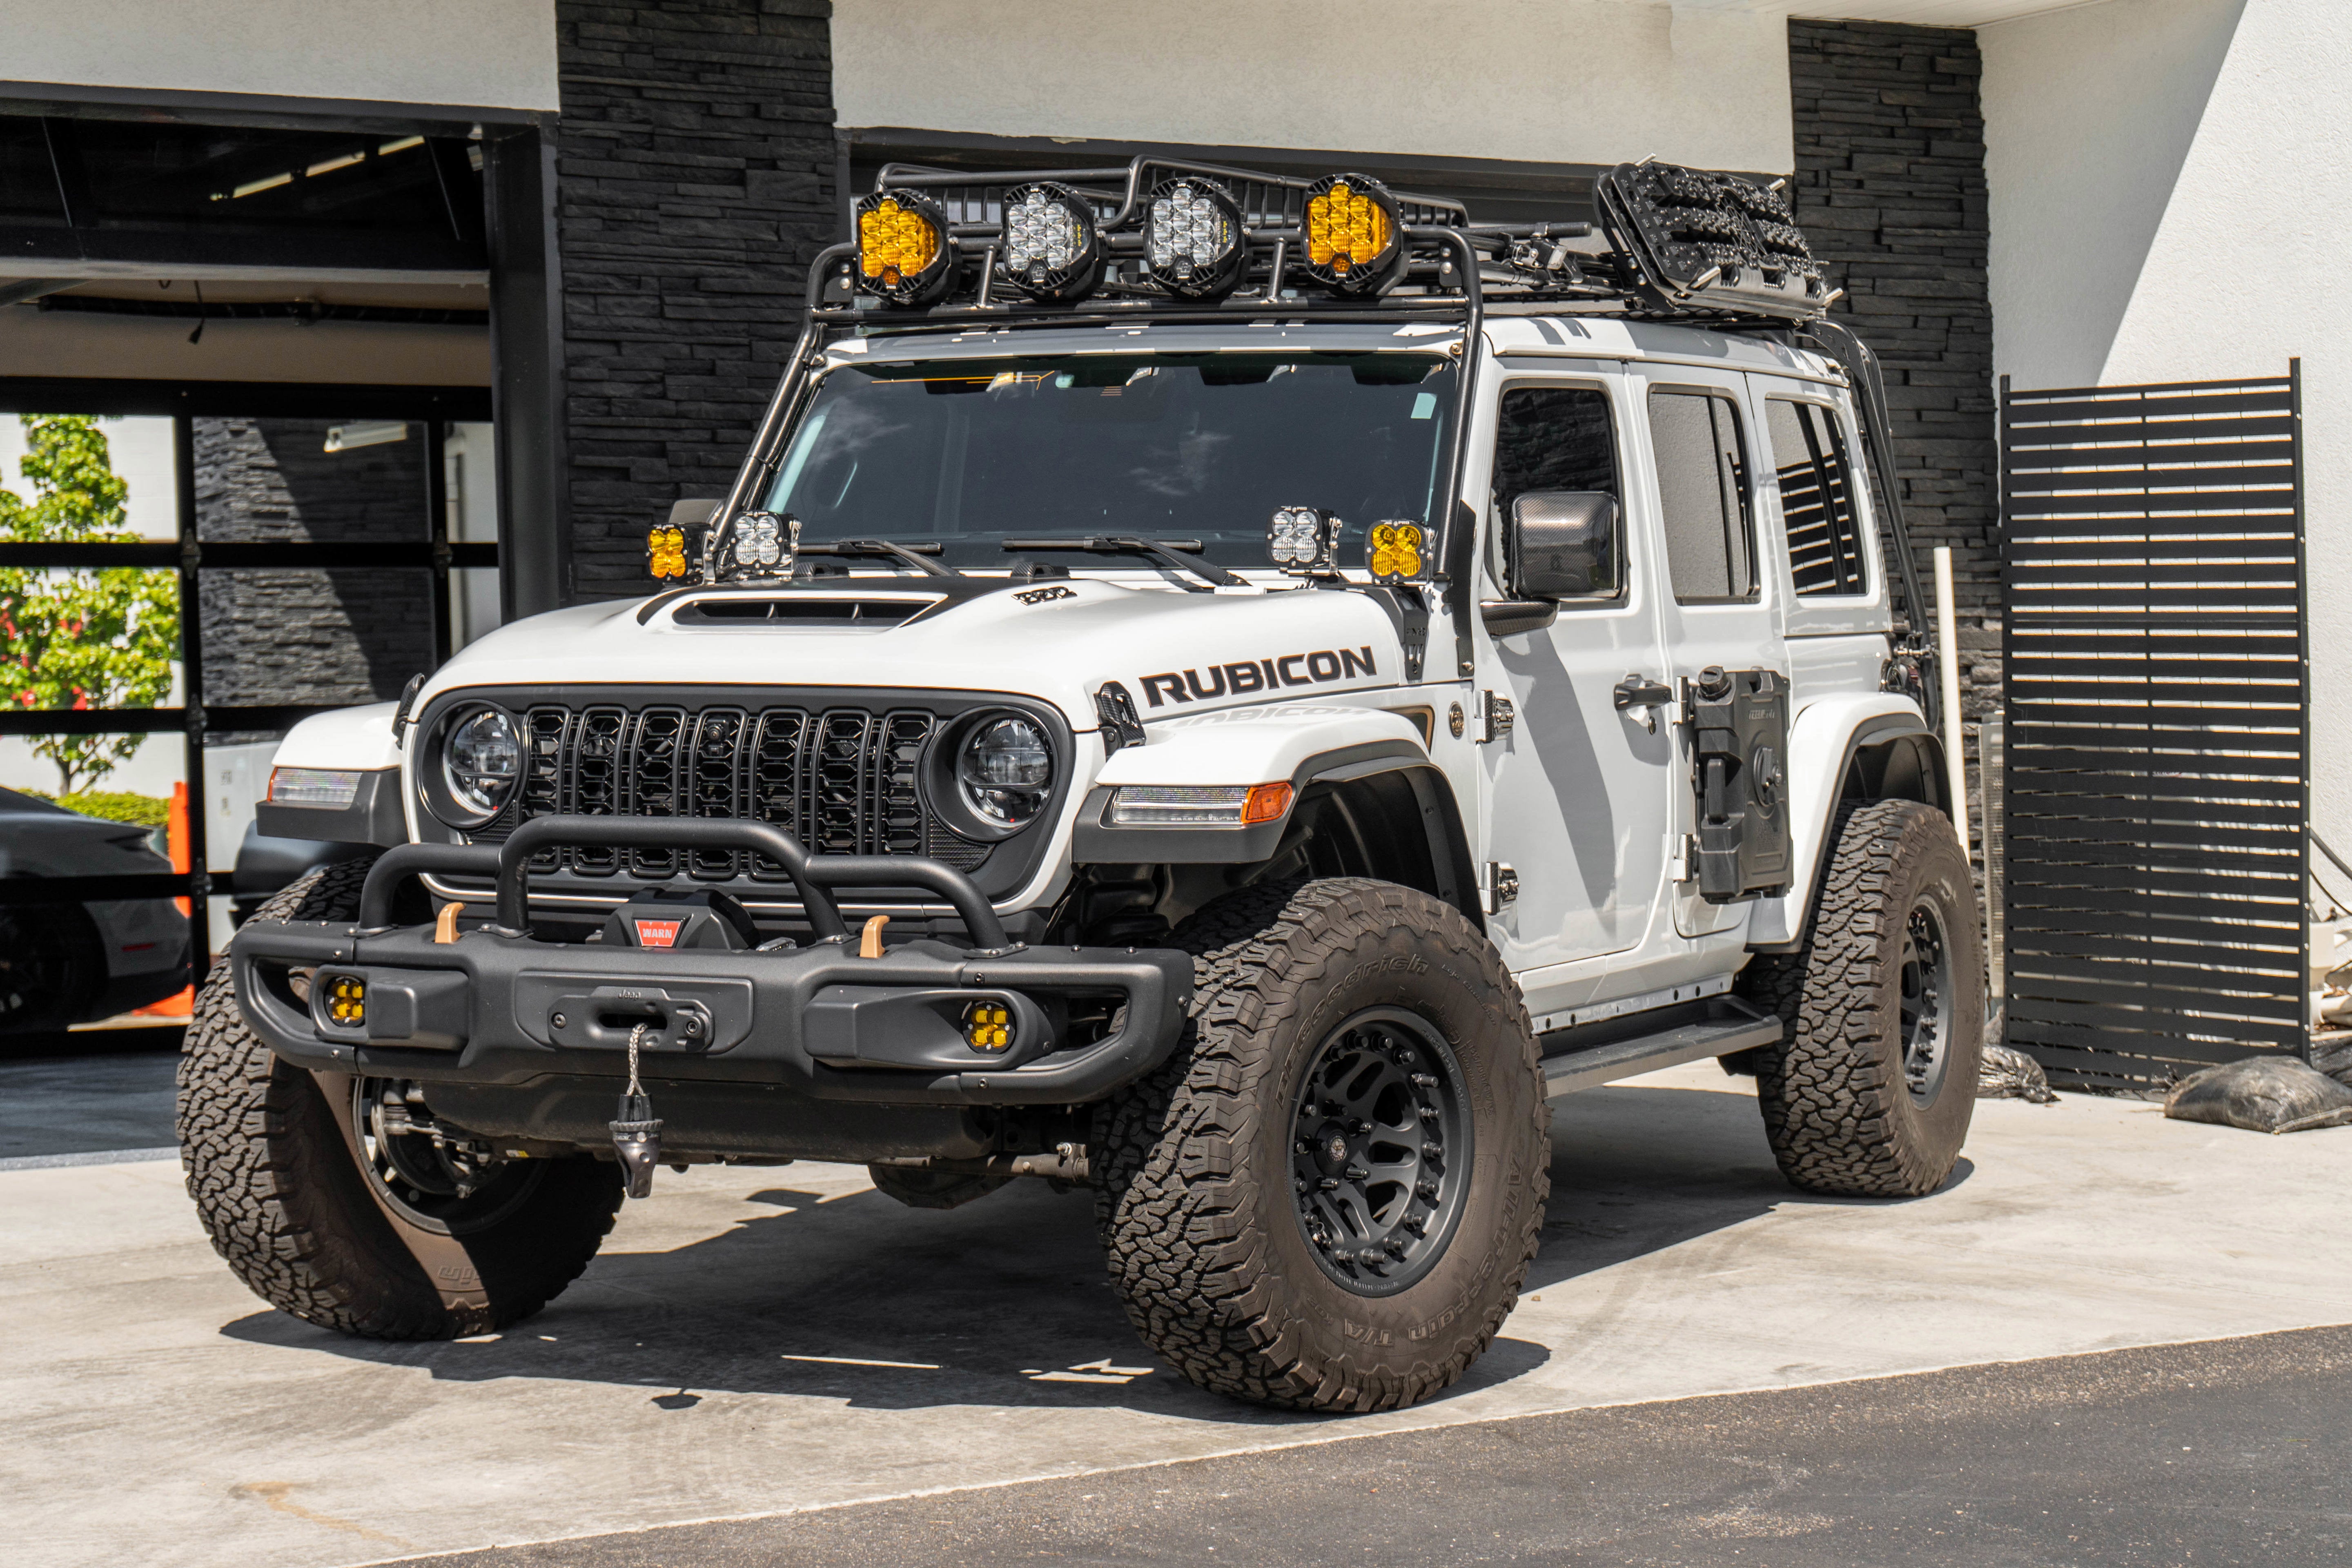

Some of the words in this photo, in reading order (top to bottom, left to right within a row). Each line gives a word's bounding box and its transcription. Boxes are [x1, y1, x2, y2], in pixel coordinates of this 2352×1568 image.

[1138, 645, 1377, 708] RUBICON
[642, 928, 672, 938] WARN
[618, 989, 641, 1000] Jeep
[1275, 953, 1429, 1110] BFGoodrich
[1408, 1152, 1522, 1342] All-Terrain
[1345, 1318, 1393, 1347] T/A
